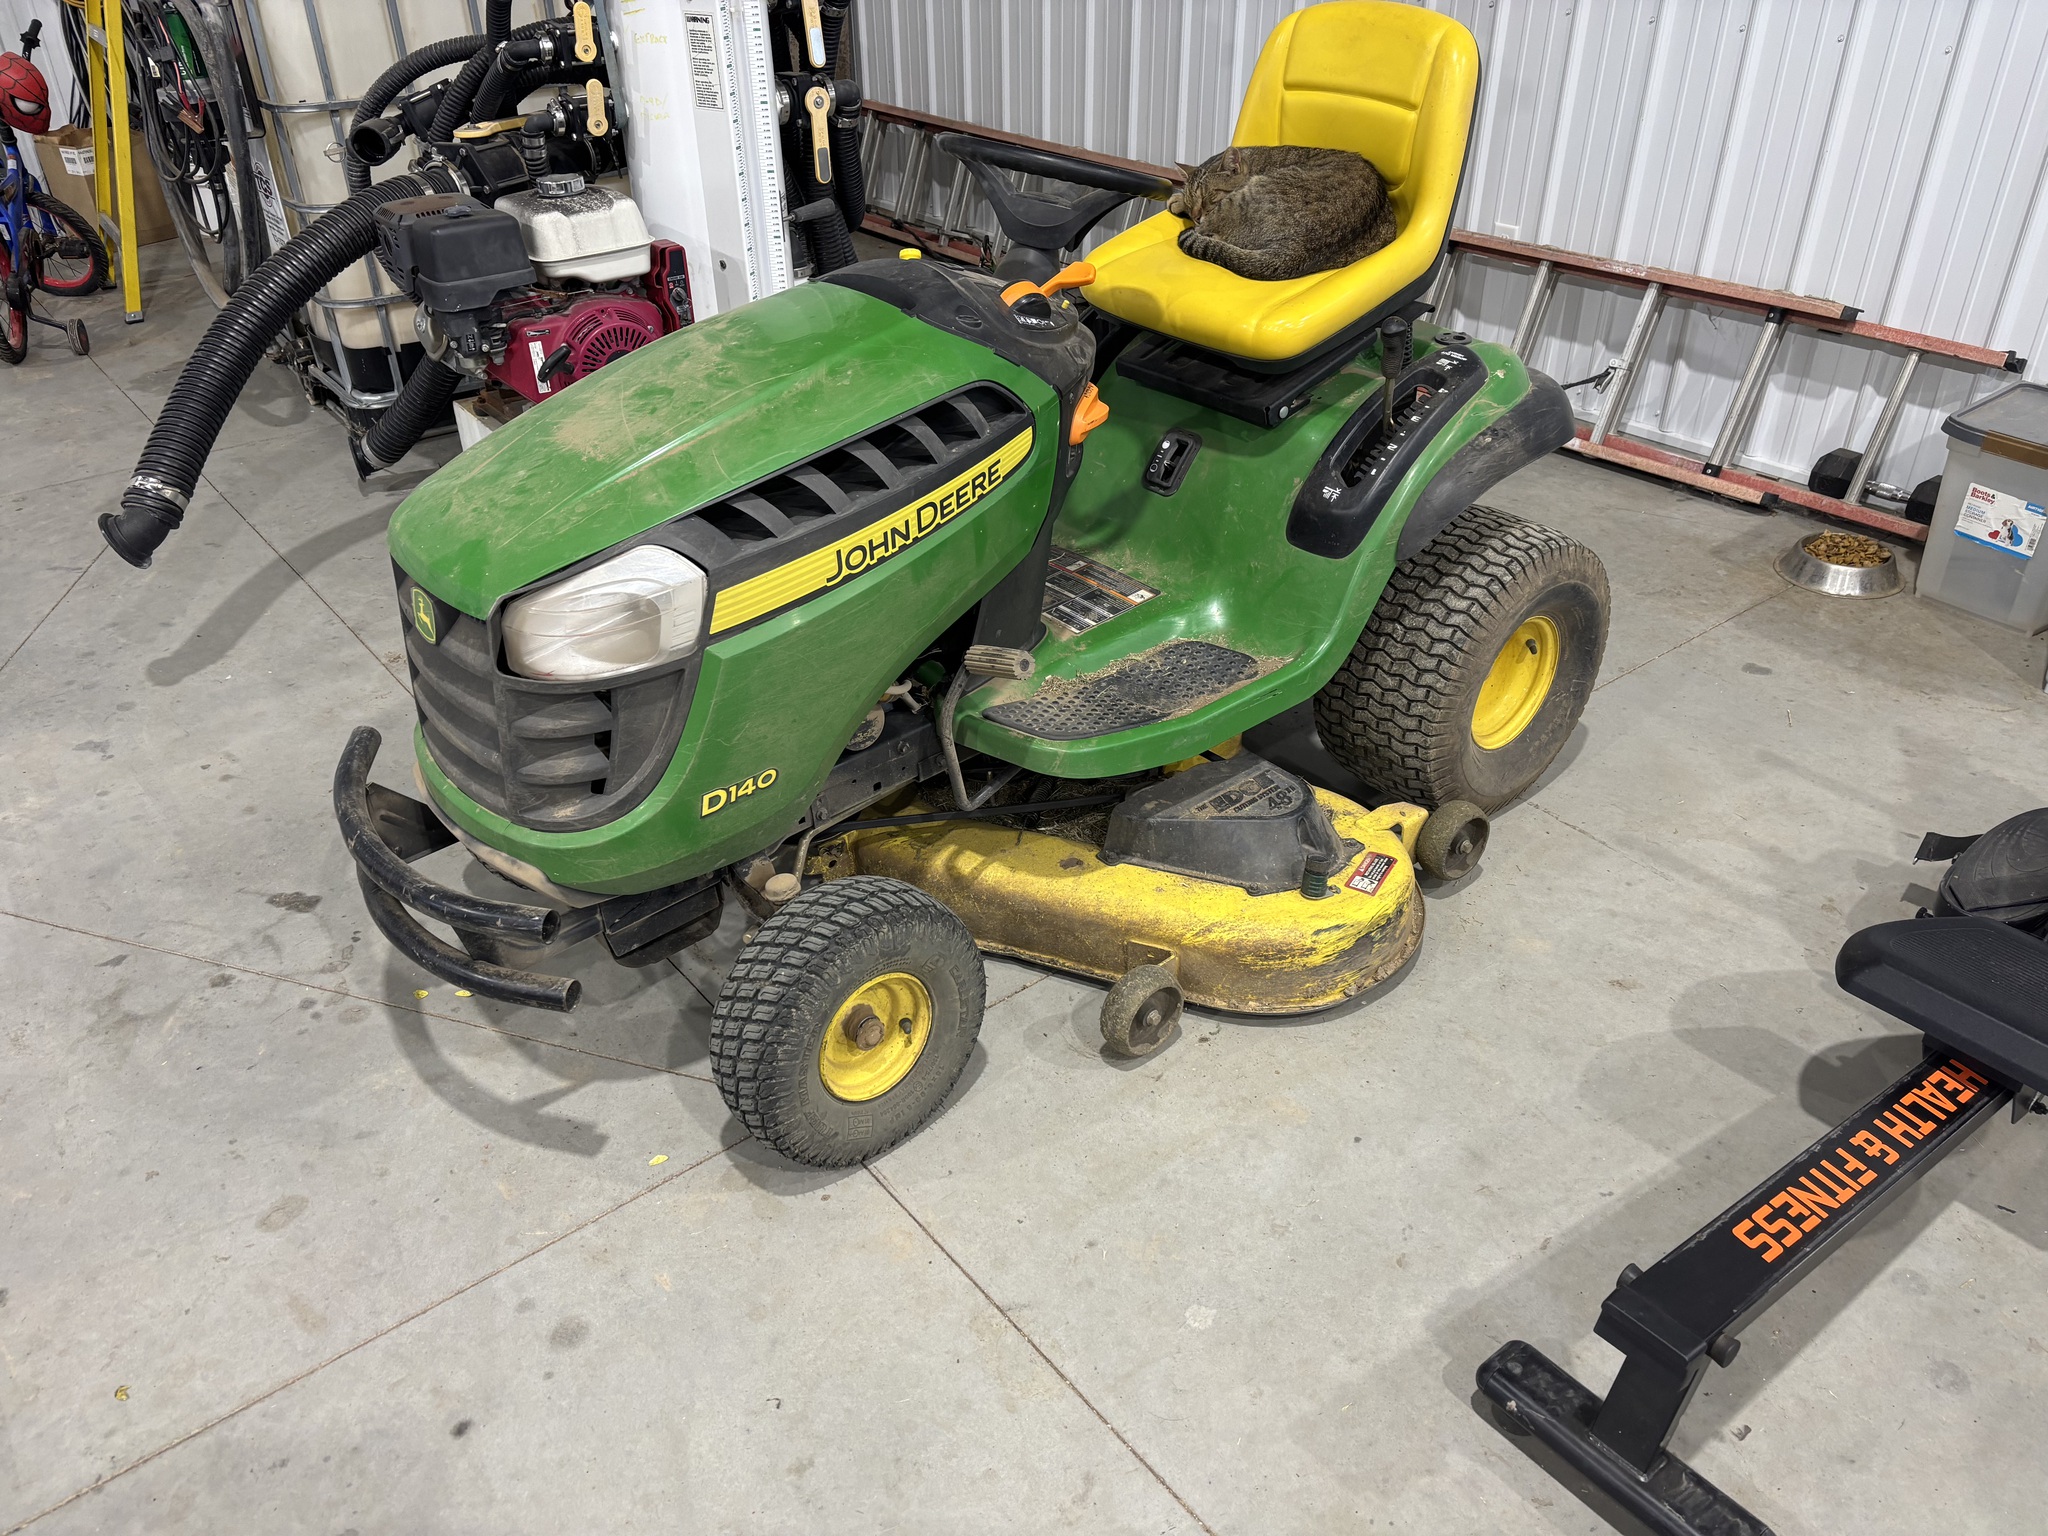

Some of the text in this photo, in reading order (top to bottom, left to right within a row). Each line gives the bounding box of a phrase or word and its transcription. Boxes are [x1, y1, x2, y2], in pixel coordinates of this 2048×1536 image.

[1970, 492, 1995, 504] Barkley
[1972, 487, 1991, 498] Boots
[826, 459, 1004, 584] JOHN DEERE
[1965, 510, 1984, 519] STORAGE
[1966, 505, 1986, 515] MEDIUM
[701, 768, 777, 817] D140
[799, 1021, 822, 1106] MASTER
[1732, 1059, 1988, 1263] HEALTH & FITNESS
